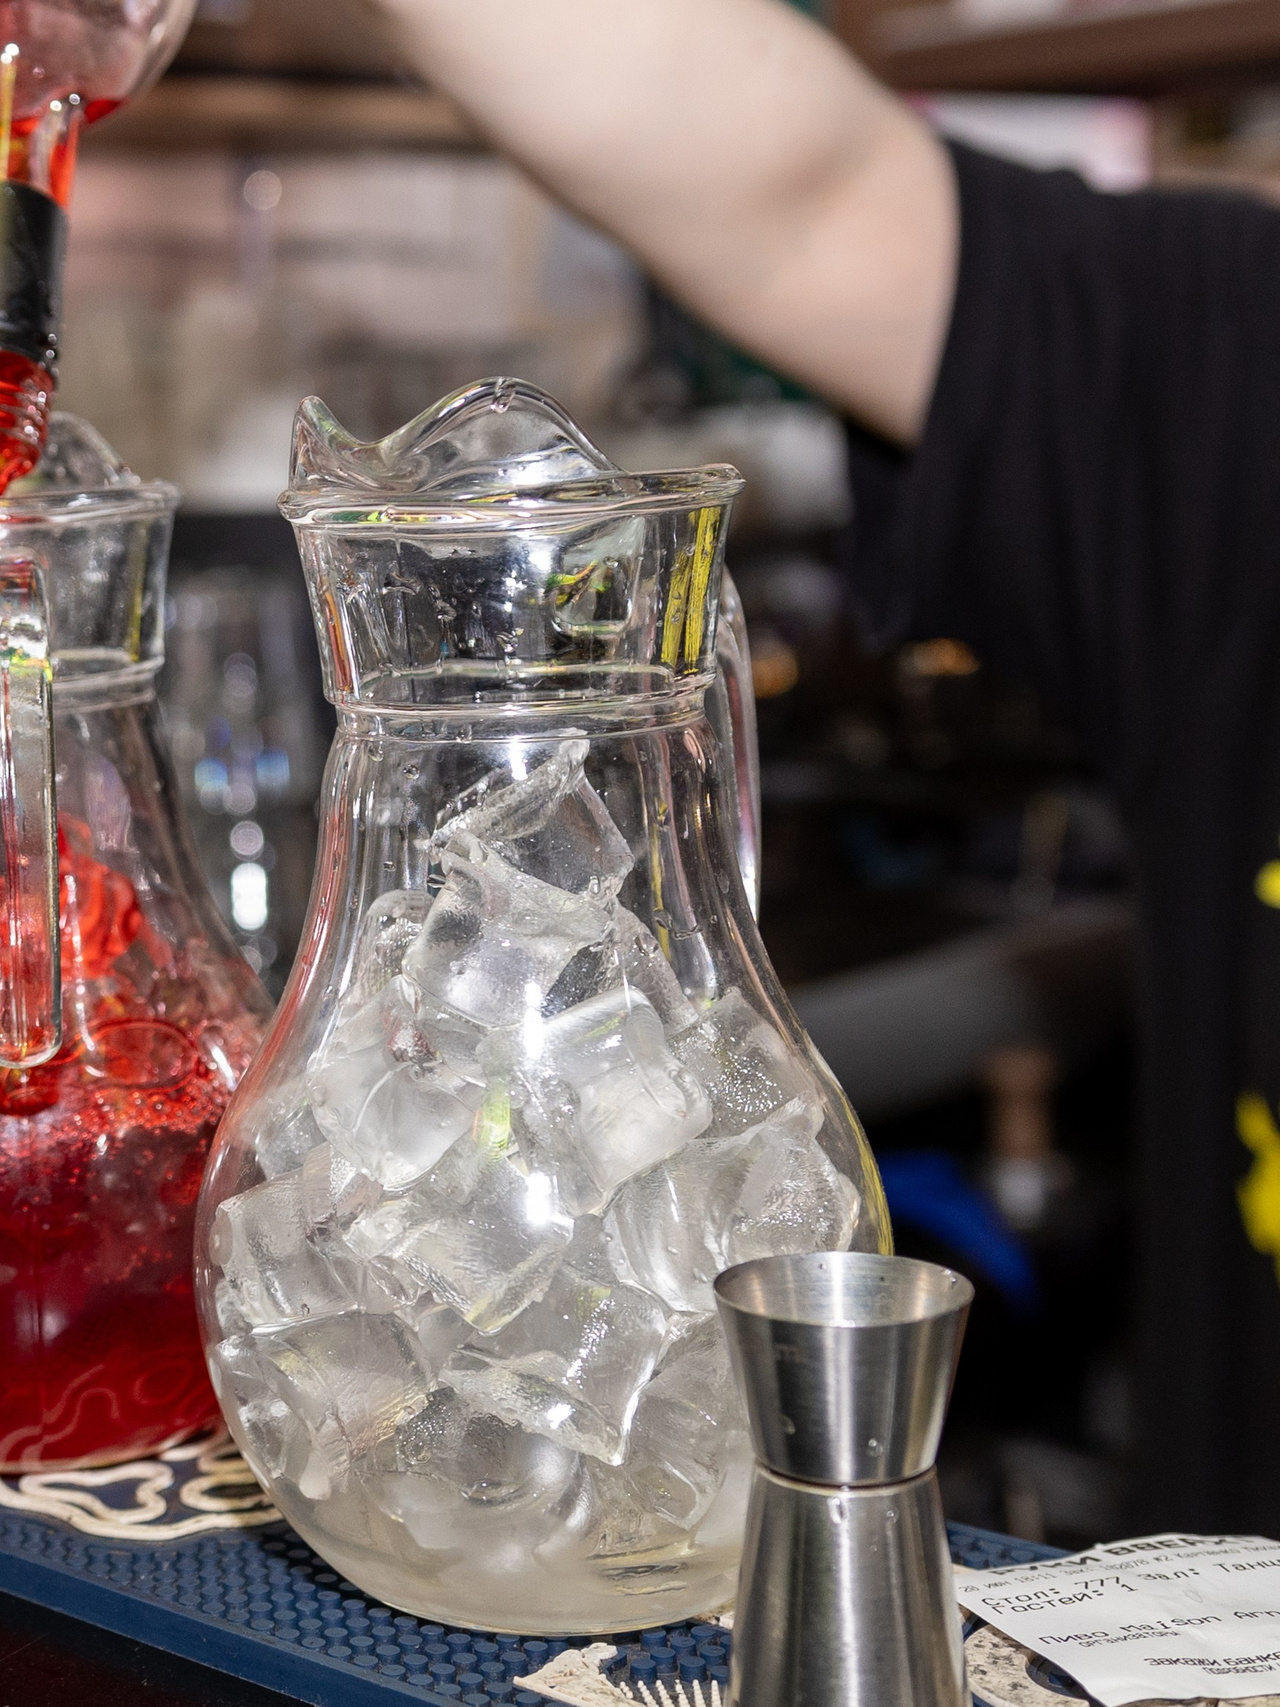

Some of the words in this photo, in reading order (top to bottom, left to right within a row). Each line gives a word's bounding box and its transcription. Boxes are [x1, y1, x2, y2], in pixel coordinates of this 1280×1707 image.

[981, 1587, 1061, 1607] Стол:
[1074, 1576, 1121, 1590] 777
[1137, 1567, 1200, 1581] Зал:
[1212, 1559, 1280, 1574] Танц
[991, 1589, 1105, 1615] Гостей:
[1121, 1583, 1139, 1593] 1
[1038, 1631, 1110, 1646] Пиво
[1119, 1615, 1223, 1633] Maison
